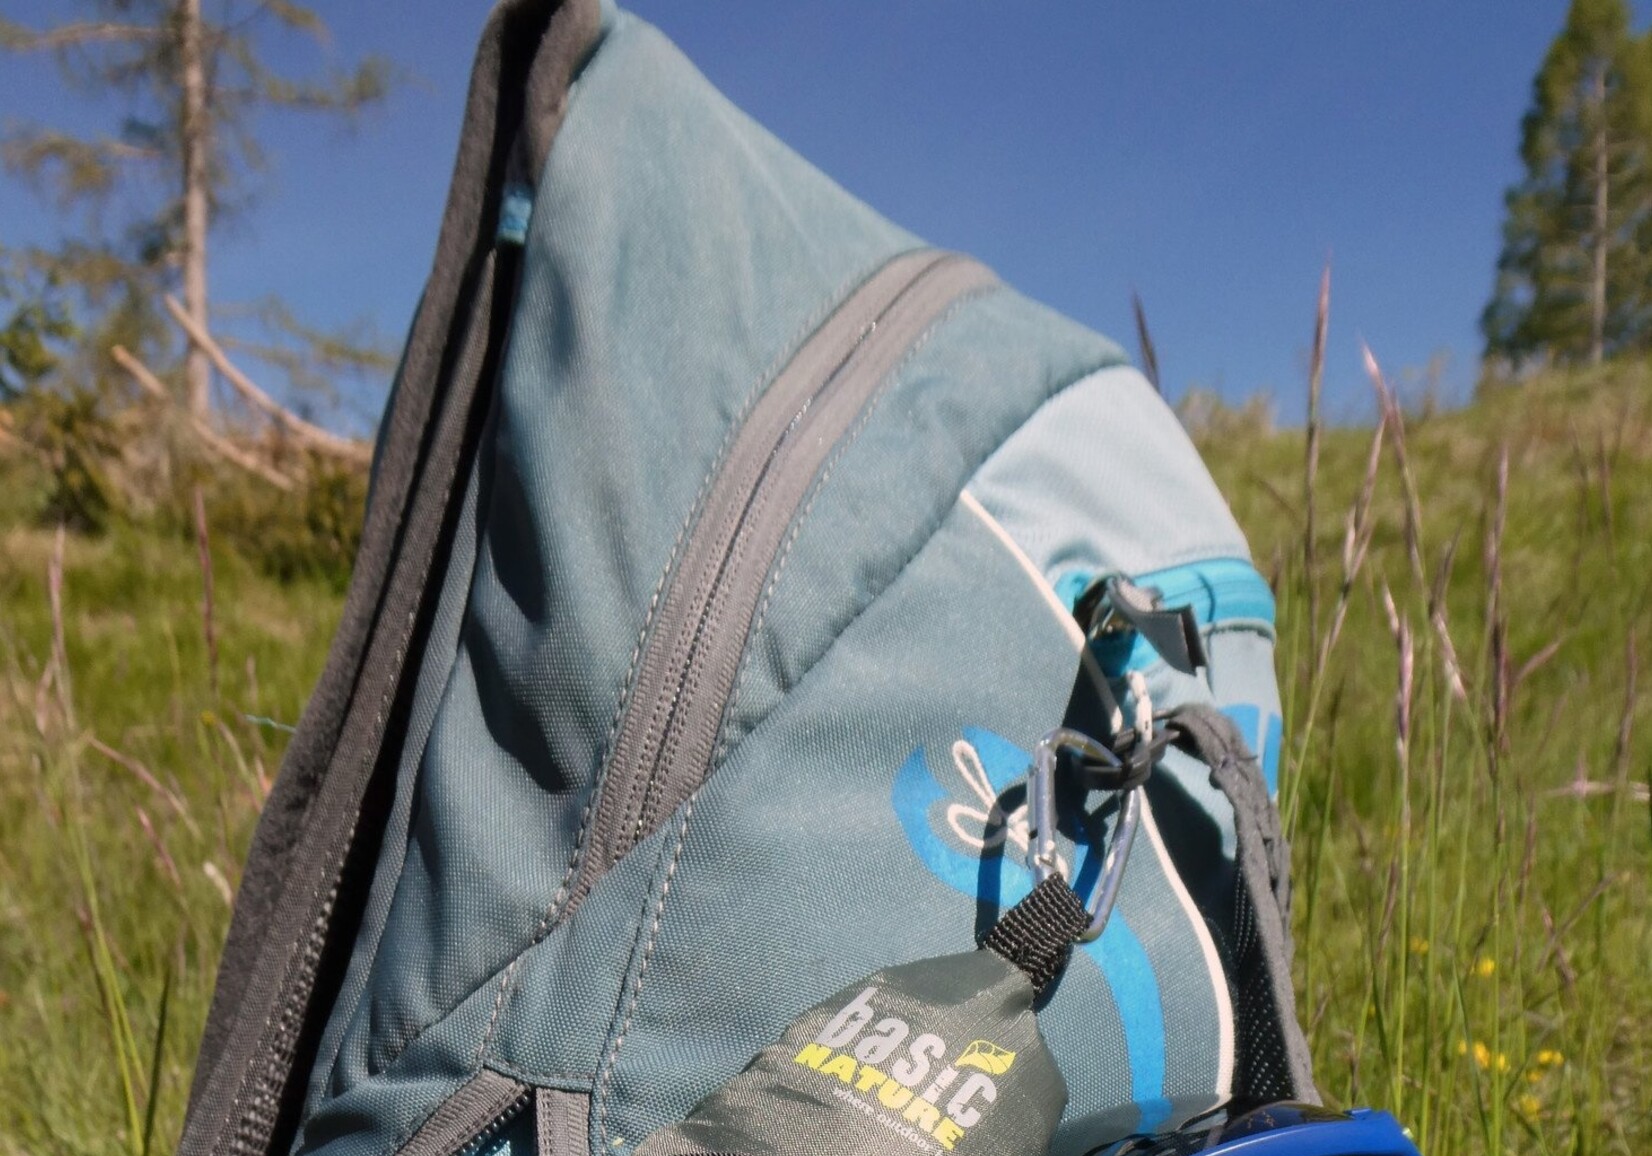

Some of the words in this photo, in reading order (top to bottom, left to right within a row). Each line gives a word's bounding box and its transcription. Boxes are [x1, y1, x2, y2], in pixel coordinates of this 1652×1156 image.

[794, 1043, 965, 1150] NATURE
[815, 986, 998, 1127] basic
[832, 1087, 874, 1115] where
[876, 1113, 931, 1151] outdoor
